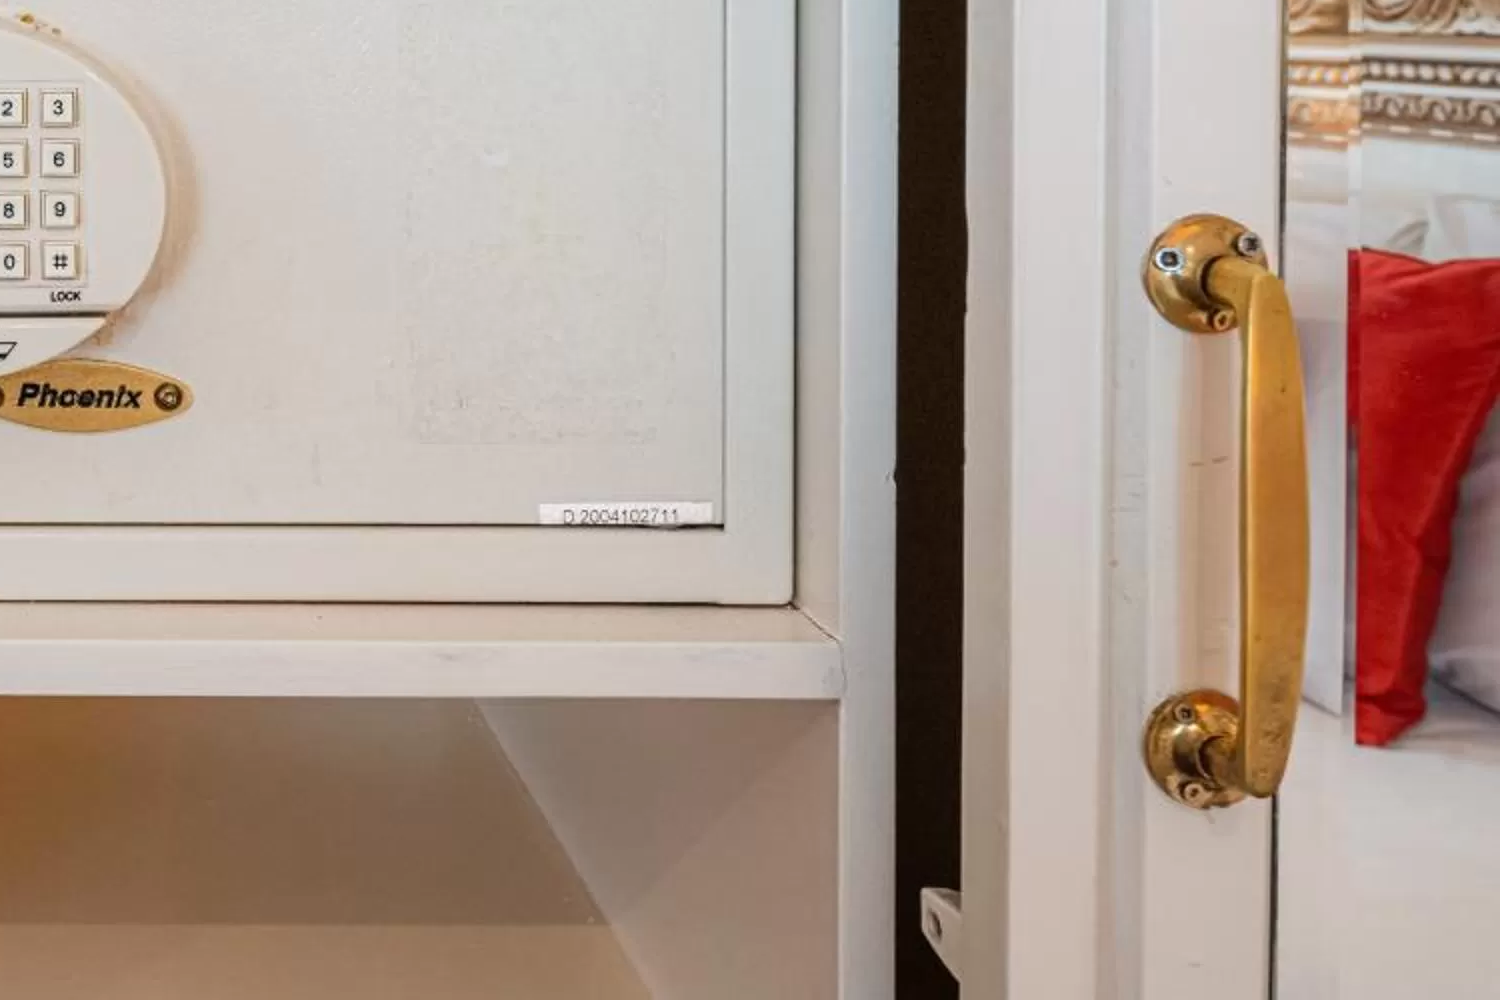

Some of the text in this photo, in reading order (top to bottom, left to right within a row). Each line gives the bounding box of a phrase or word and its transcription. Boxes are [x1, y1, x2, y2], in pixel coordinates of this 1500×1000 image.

[1, 101, 13, 117] 2
[53, 100, 64, 115] 3
[3, 152, 14, 168] 5
[53, 152, 65, 167] 6
[3, 202, 14, 218] 8
[54, 202, 66, 217] 9
[3, 254, 16, 270] 0
[50, 291, 81, 302] LOCK
[17, 382, 142, 408] Phoenix
